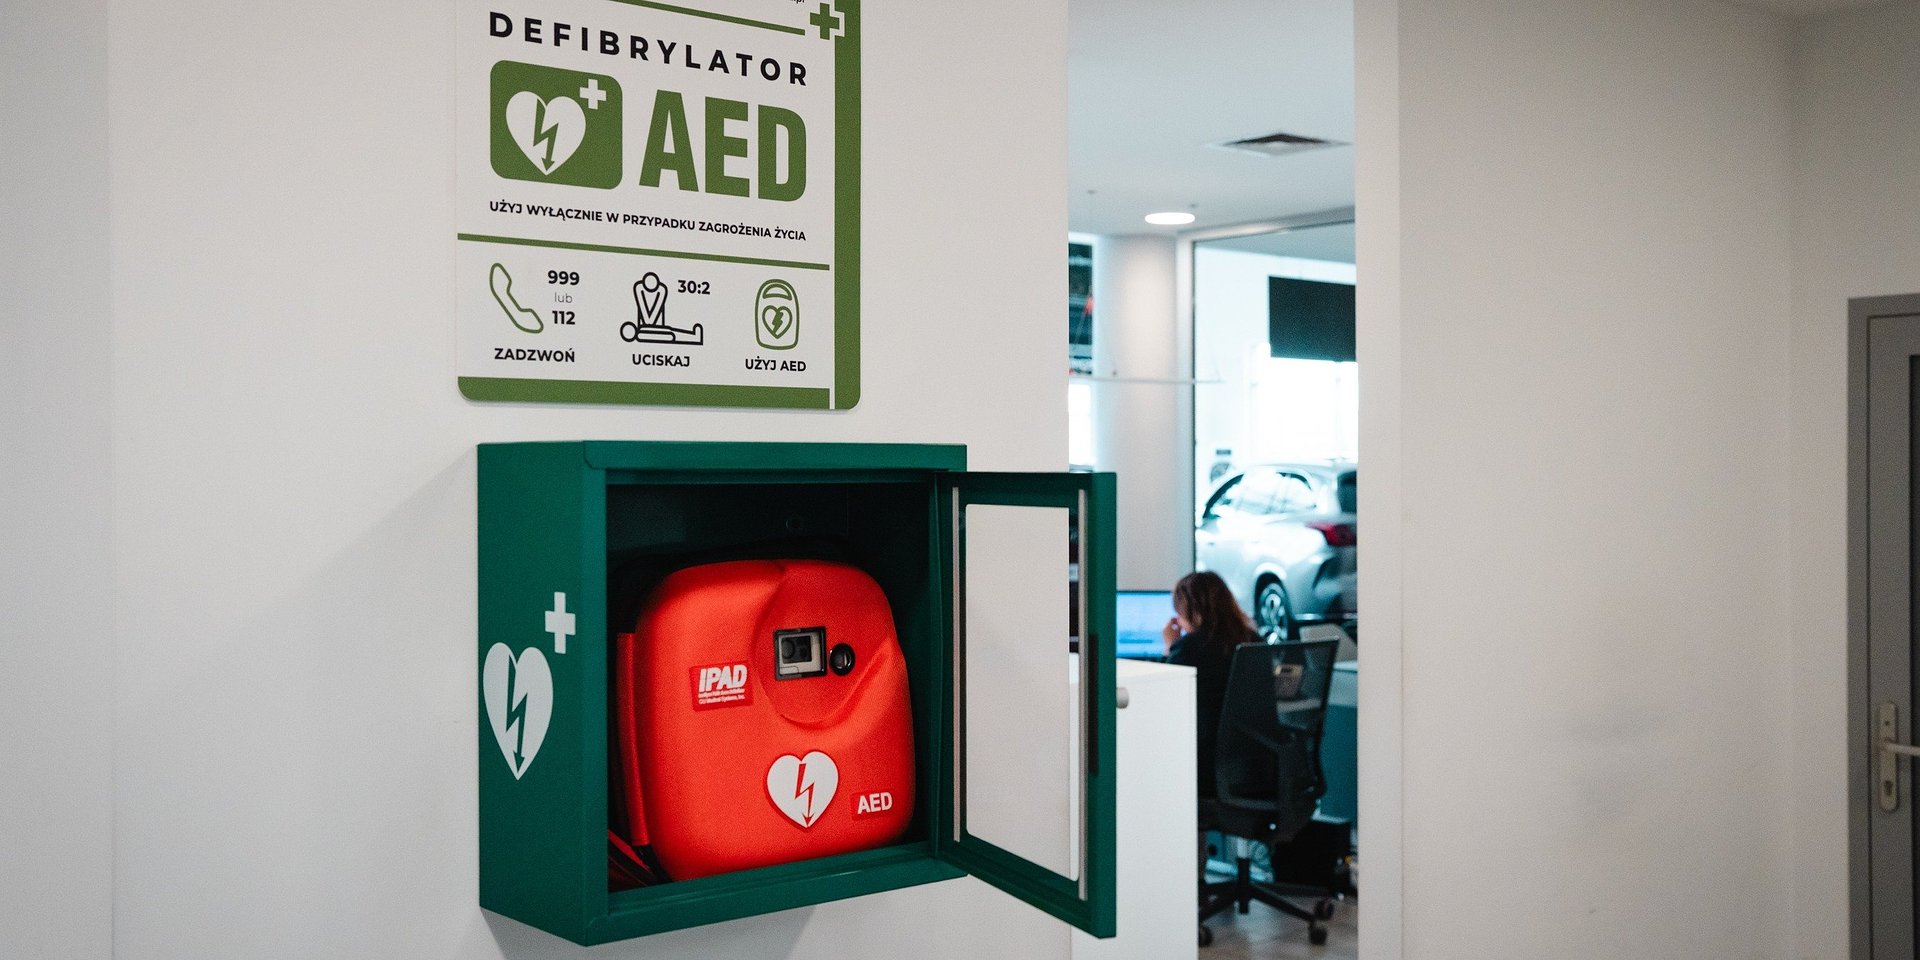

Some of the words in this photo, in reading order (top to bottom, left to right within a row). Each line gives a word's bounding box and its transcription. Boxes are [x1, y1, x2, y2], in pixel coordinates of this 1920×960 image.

[489, 11, 807, 87] DEFIBRYLATOR
[638, 89, 807, 202] AED
[489, 199, 523, 215] UŻYJ
[526, 204, 603, 222] WYŁĄCZNIE
[606, 211, 620, 224] W
[622, 213, 696, 231] PRZYPADKU
[698, 221, 772, 239] ZAGROŻENIA
[774, 225, 807, 241] ŻYCIA
[547, 269, 581, 287] 999
[677, 279, 711, 296] 30:2
[553, 291, 574, 304] lub
[551, 309, 576, 326] 112
[493, 347, 576, 363] ZADZWOŃ
[631, 353, 691, 368] UCISKAJ
[744, 355, 777, 371] UŻYJ
[779, 359, 807, 373] AED
[698, 664, 748, 692] IPAD
[857, 791, 893, 814] AED
